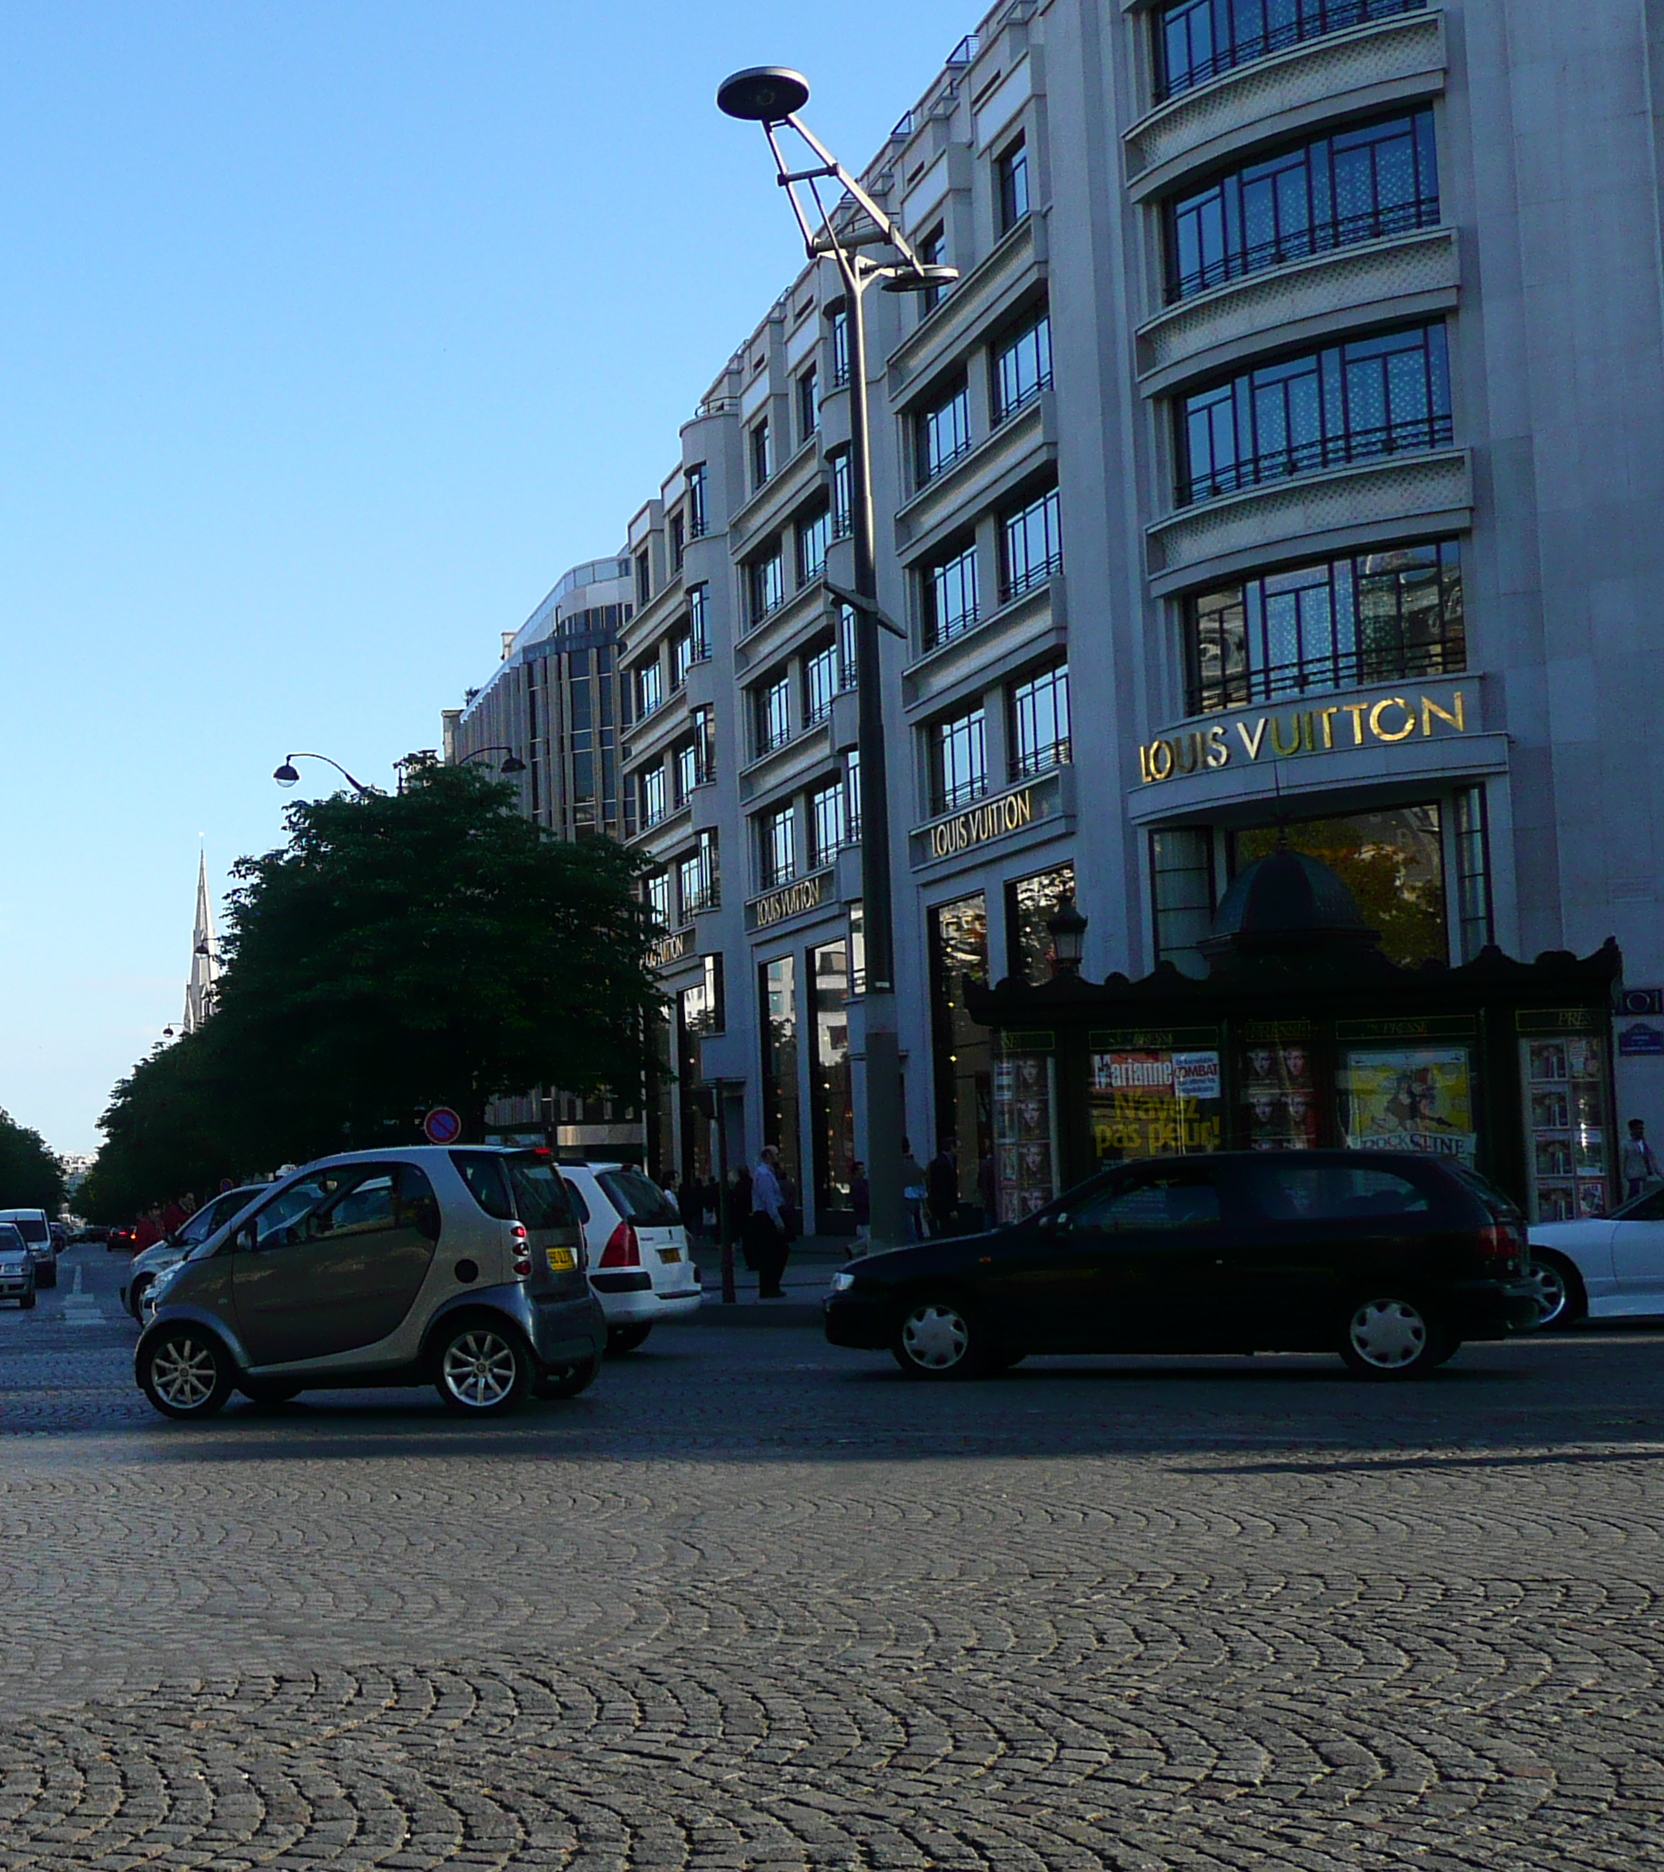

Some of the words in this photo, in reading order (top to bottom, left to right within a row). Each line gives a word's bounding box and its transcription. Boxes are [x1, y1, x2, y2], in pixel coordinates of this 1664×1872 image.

[1139, 726, 1231, 783] LOUIS
[1236, 691, 1465, 760] VUITTON
[930, 815, 968, 857] LOUIS
[968, 789, 1031, 843] VUITTON
[756, 894, 781, 926] LOUIS
[780, 877, 820, 916] VUITTON
[1094, 1053, 1173, 1089] Marianne
[1173, 1063, 1218, 1079] COMBAT
[1114, 1090, 1200, 1121] N'ayez
[1094, 1123, 1141, 1158] pas
